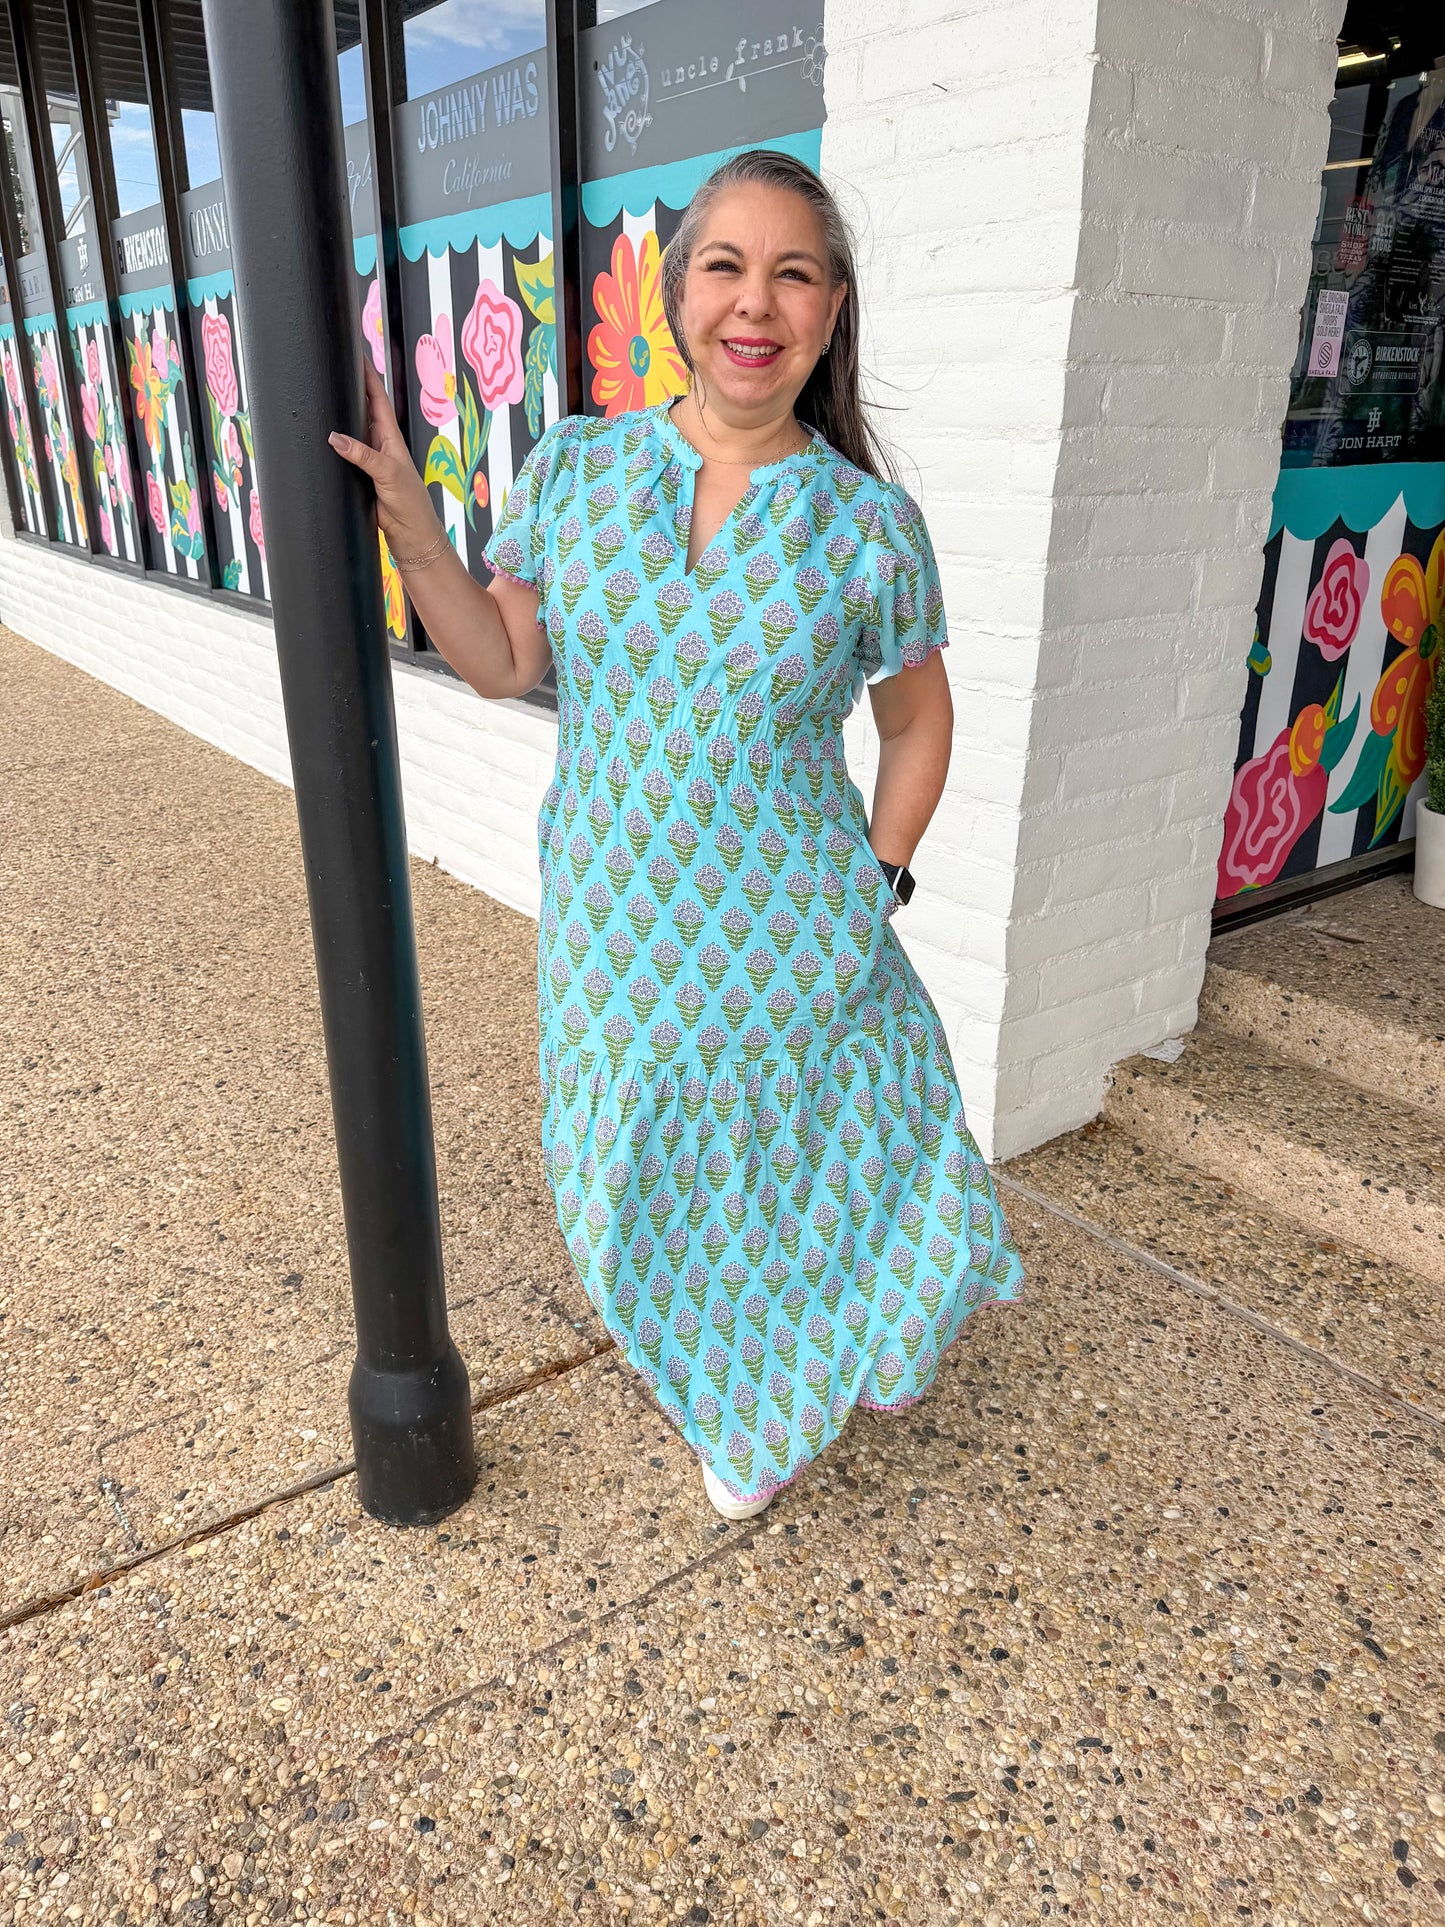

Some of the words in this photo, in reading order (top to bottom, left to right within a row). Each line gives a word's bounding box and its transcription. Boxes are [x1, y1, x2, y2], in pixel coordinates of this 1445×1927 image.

[661, 54, 721, 88] uncle
[733, 25, 806, 67] frank
[417, 79, 490, 153] JOHNNY
[492, 62, 540, 128] WAS
[442, 150, 514, 202] California
[1345, 206, 1370, 225] BEST
[1341, 240, 1364, 250] SHOP
[1375, 346, 1420, 362] BIRKENSTOCK
[1339, 436, 1364, 449] JON
[1366, 435, 1402, 449] HART
